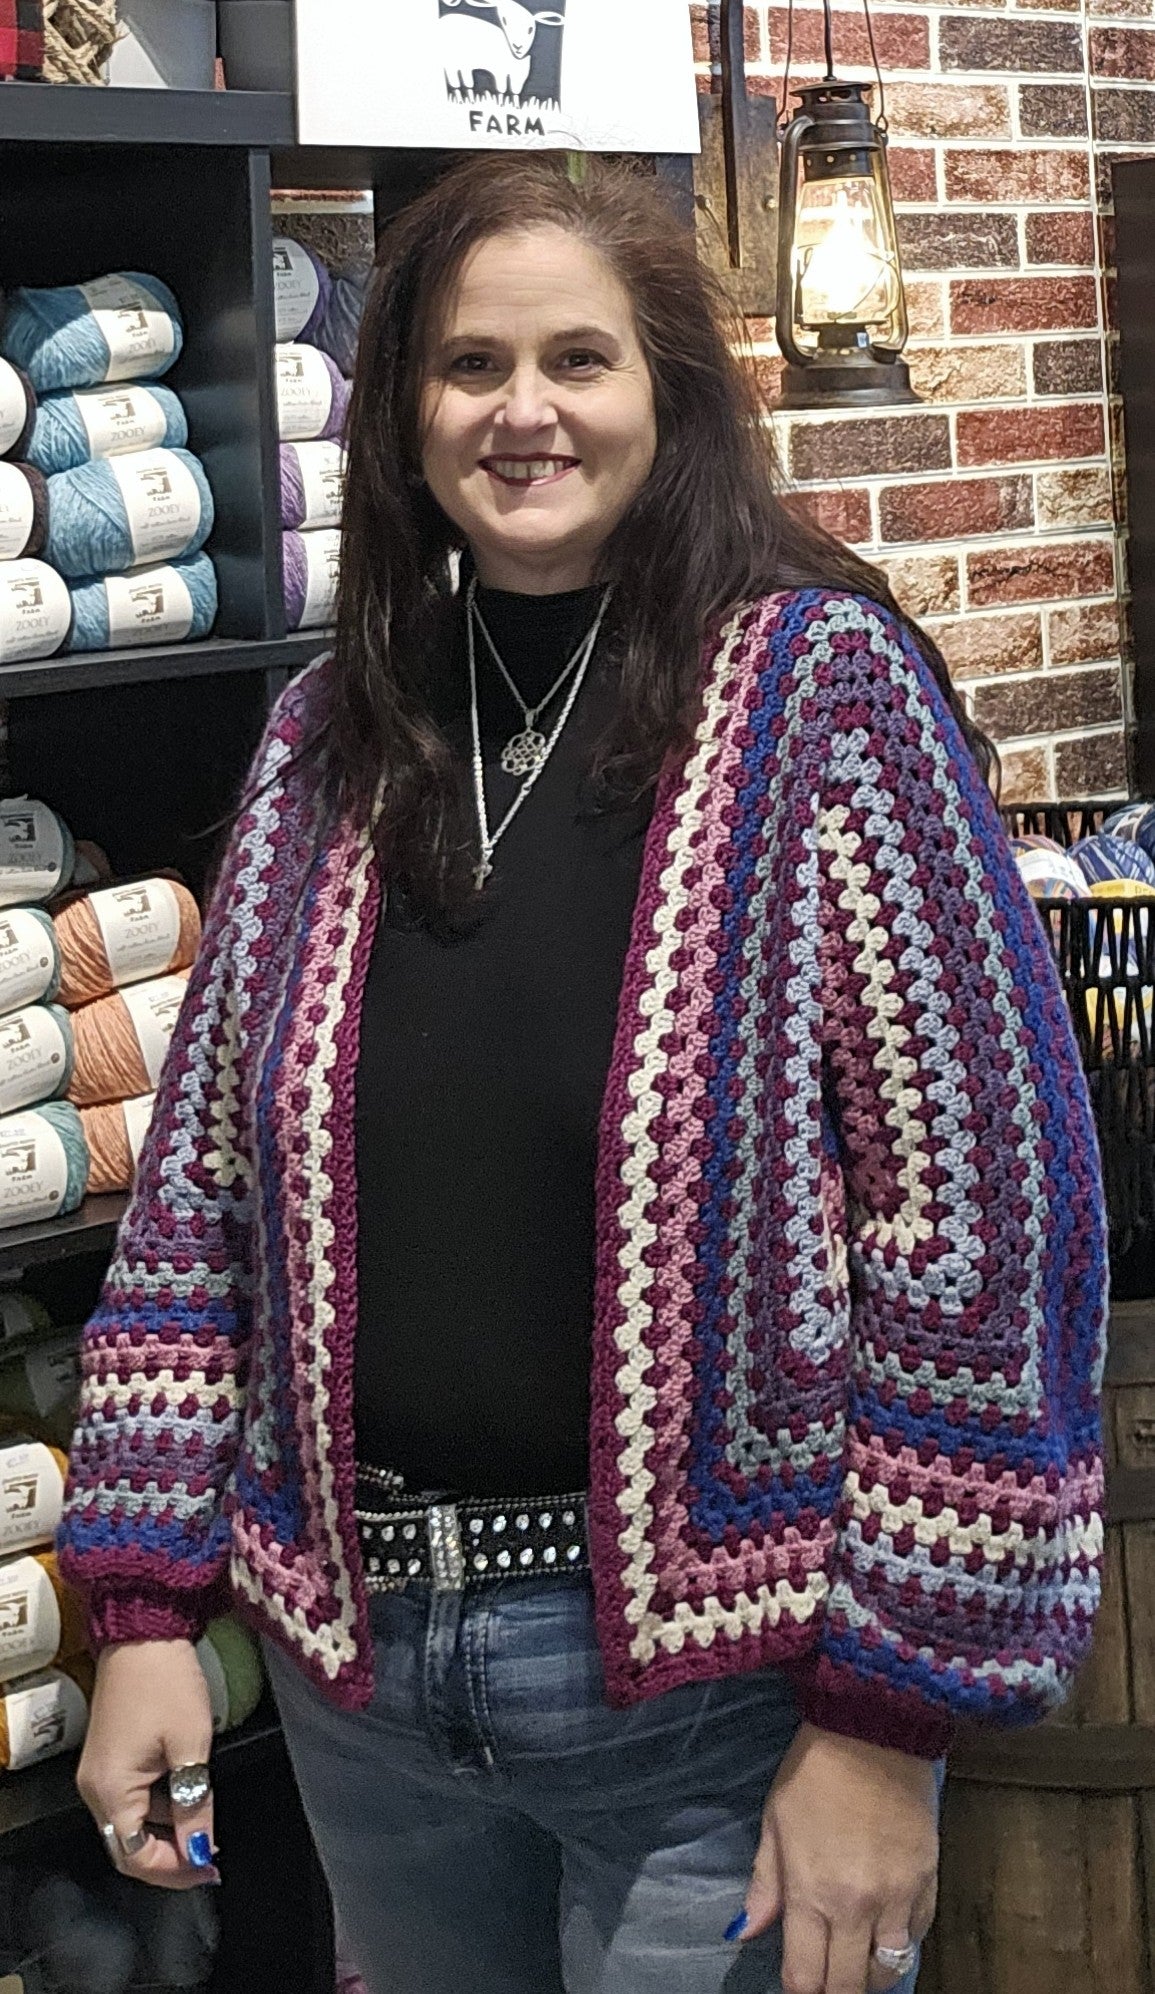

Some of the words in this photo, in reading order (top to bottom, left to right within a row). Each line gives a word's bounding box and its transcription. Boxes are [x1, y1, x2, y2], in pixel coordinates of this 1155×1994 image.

[469, 110, 545, 136] FARM
[111, 426, 146, 442] ZOOEY
[147, 503, 181, 518] ZOOEY
[4, 1181, 46, 1199] ZOOEY
